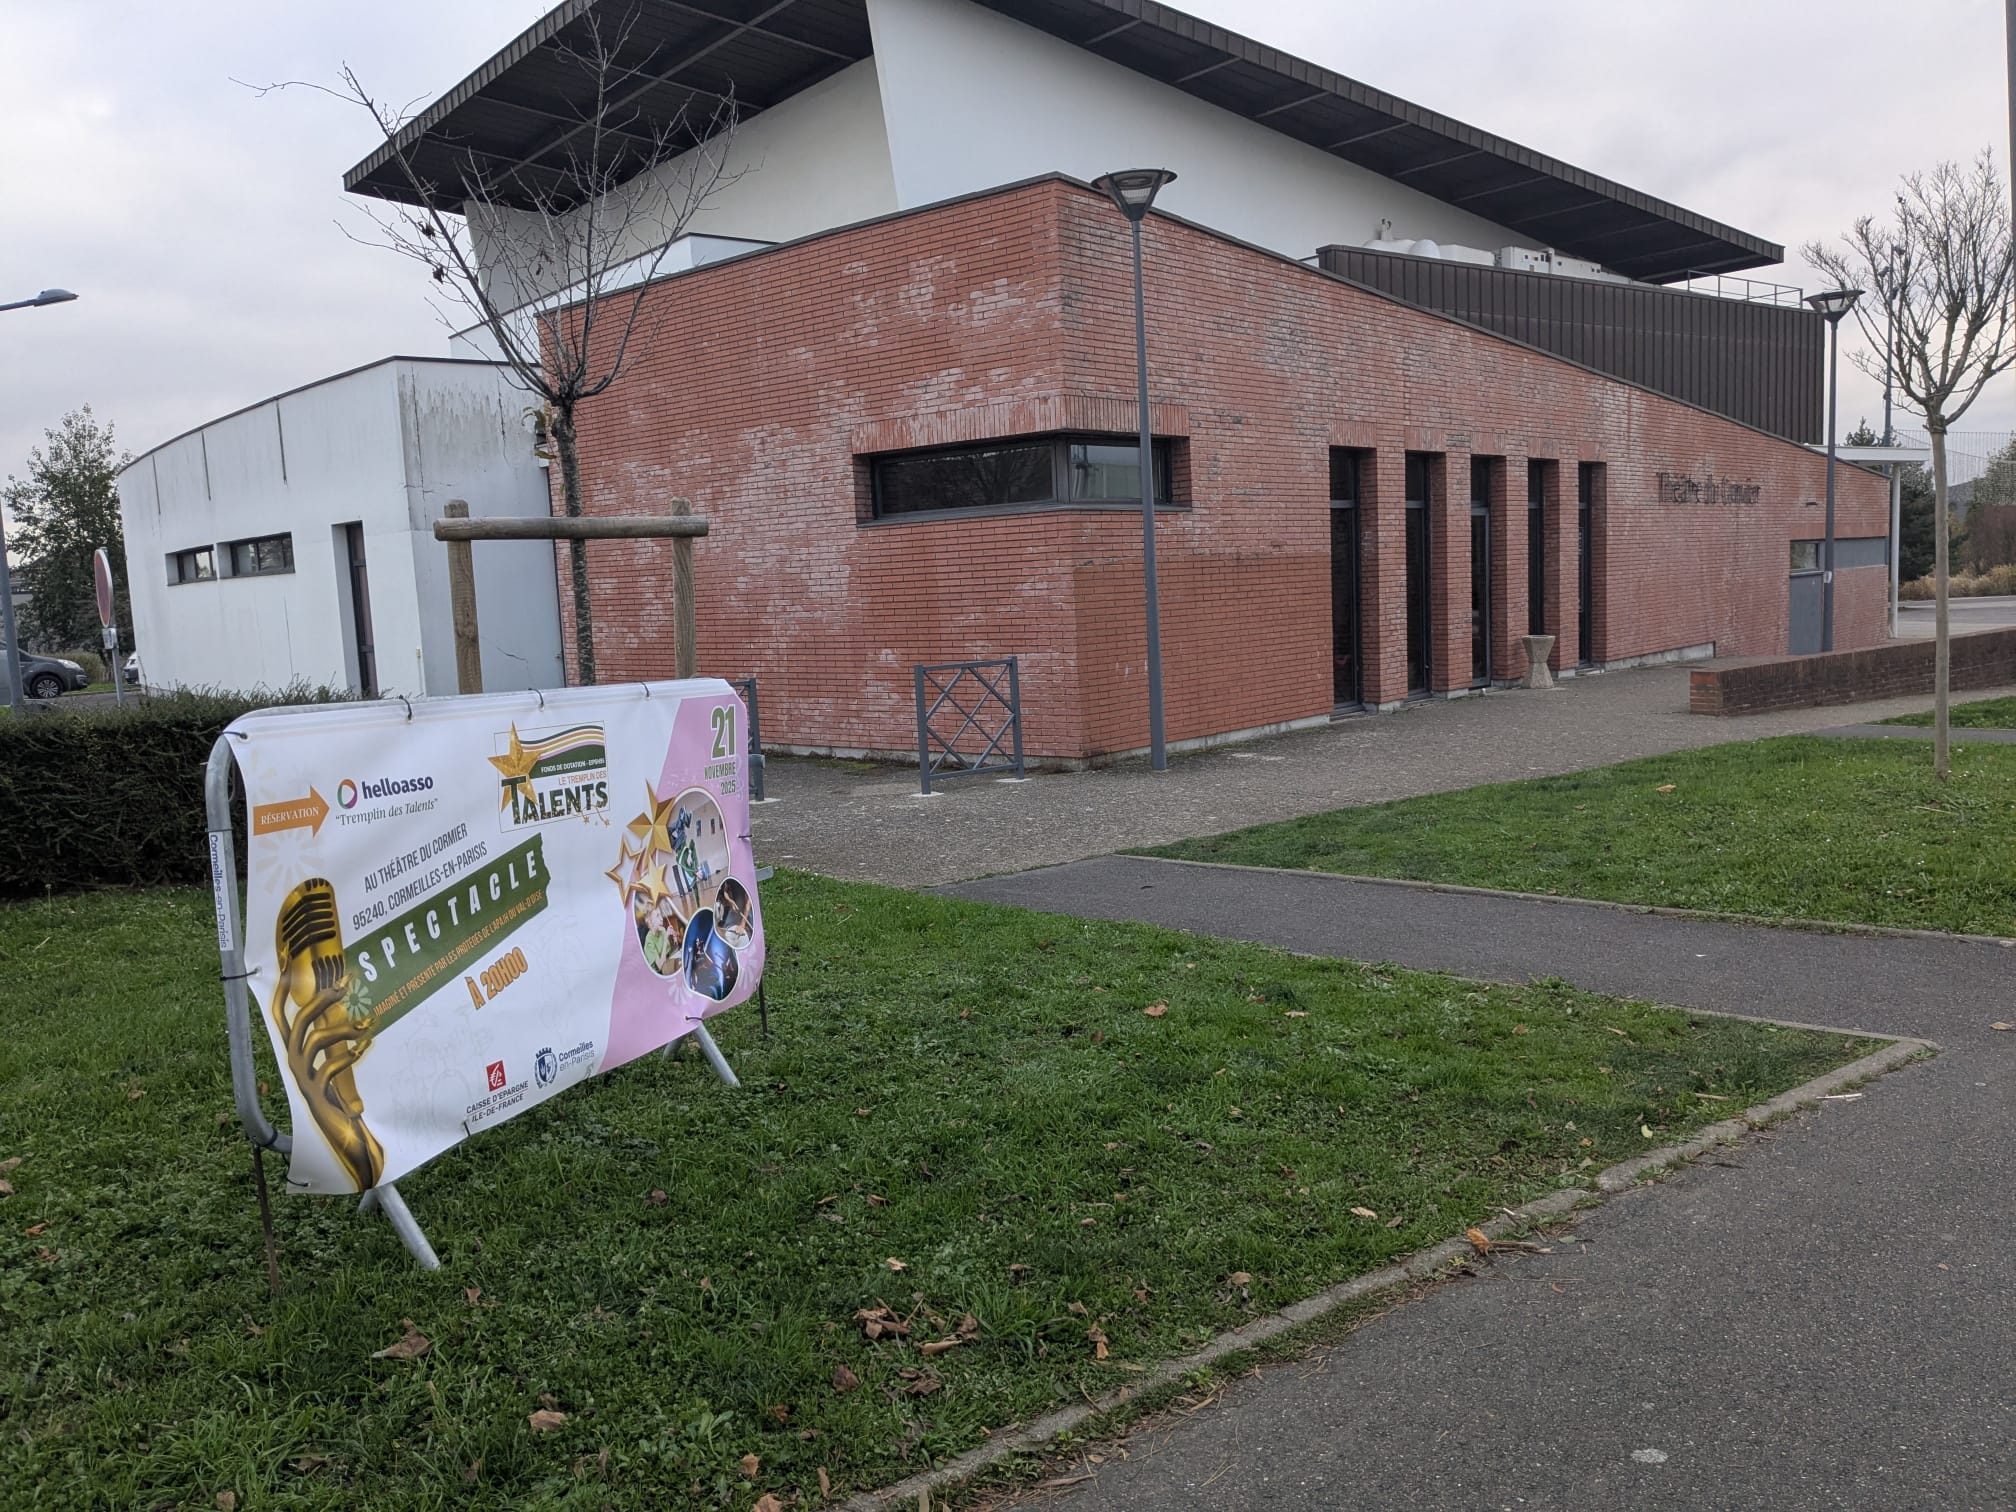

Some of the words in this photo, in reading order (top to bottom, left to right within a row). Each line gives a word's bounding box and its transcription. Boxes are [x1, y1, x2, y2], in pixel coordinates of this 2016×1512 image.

[711, 704, 736, 760] 21
[361, 776, 434, 799] helloasso
[559, 775, 567, 785] LE
[567, 772, 595, 785] TREMPLIN
[595, 770, 607, 780] DES
[704, 761, 736, 780] NOVEMBRE
[720, 780, 736, 795] 2025
[260, 806, 320, 825] RÉSERVATION
[388, 805, 403, 818] des
[501, 775, 608, 825] TALENTS
[364, 874, 378, 893] AU
[378, 856, 419, 884] THÉÂTRE
[420, 843, 432, 863] DU
[432, 823, 468, 855] CORMIER
[352, 900, 388, 931] 95240,
[387, 841, 488, 911] CORMEILLES-EN-PARISIS
[358, 850, 537, 982] SPECTACLE
[399, 985, 408, 999] ET
[434, 956, 448, 974] PAR
[446, 950, 458, 965] LES
[481, 925, 491, 939] DE
[464, 976, 486, 1010] À
[480, 946, 529, 1001] 20H00
[466, 1097, 491, 1114] CAISSE
[492, 1080, 529, 1103] D'EPARGNE
[472, 1094, 524, 1122] ILE-DE-FRANCE
